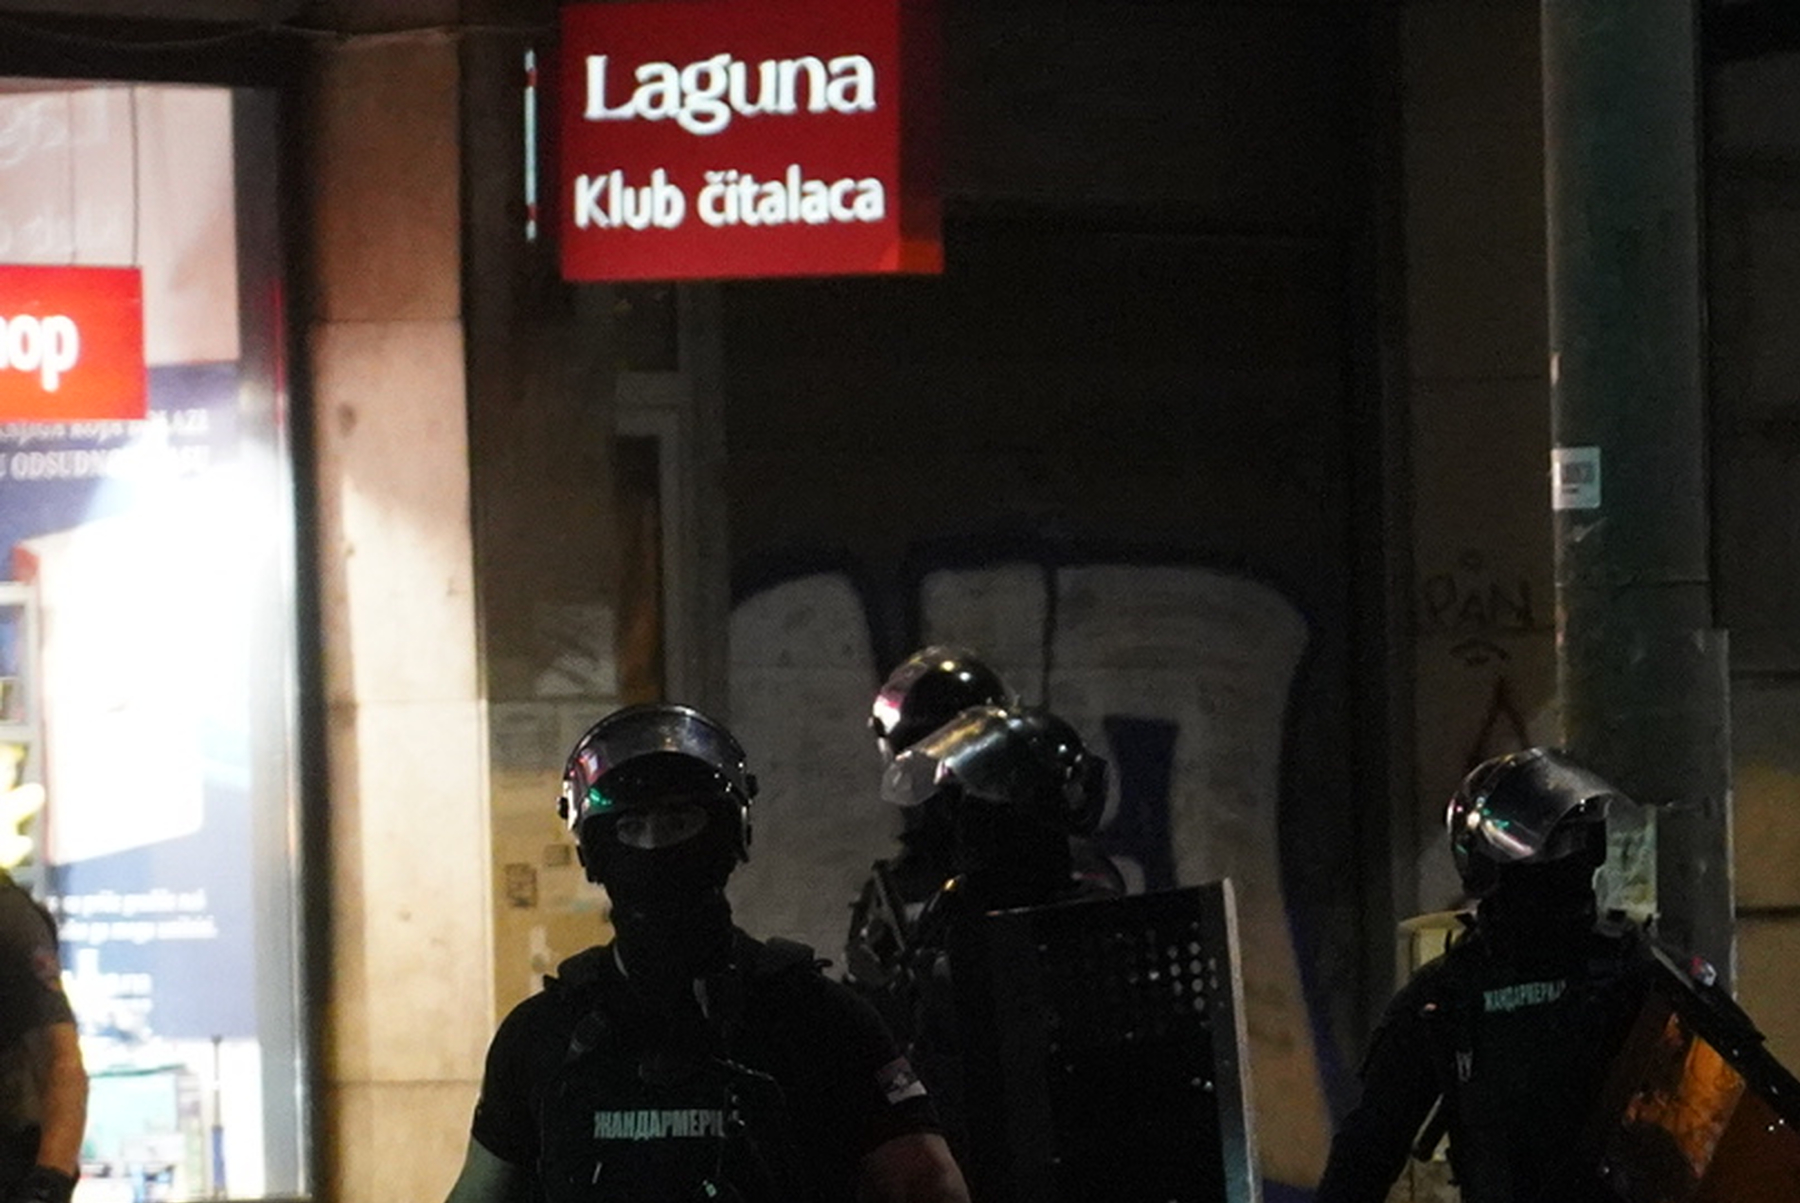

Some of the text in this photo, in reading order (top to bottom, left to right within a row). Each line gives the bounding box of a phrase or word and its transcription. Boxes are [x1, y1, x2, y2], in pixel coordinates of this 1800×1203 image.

[584, 53, 876, 136] Laguna
[573, 163, 886, 231] Klub čitalaca
